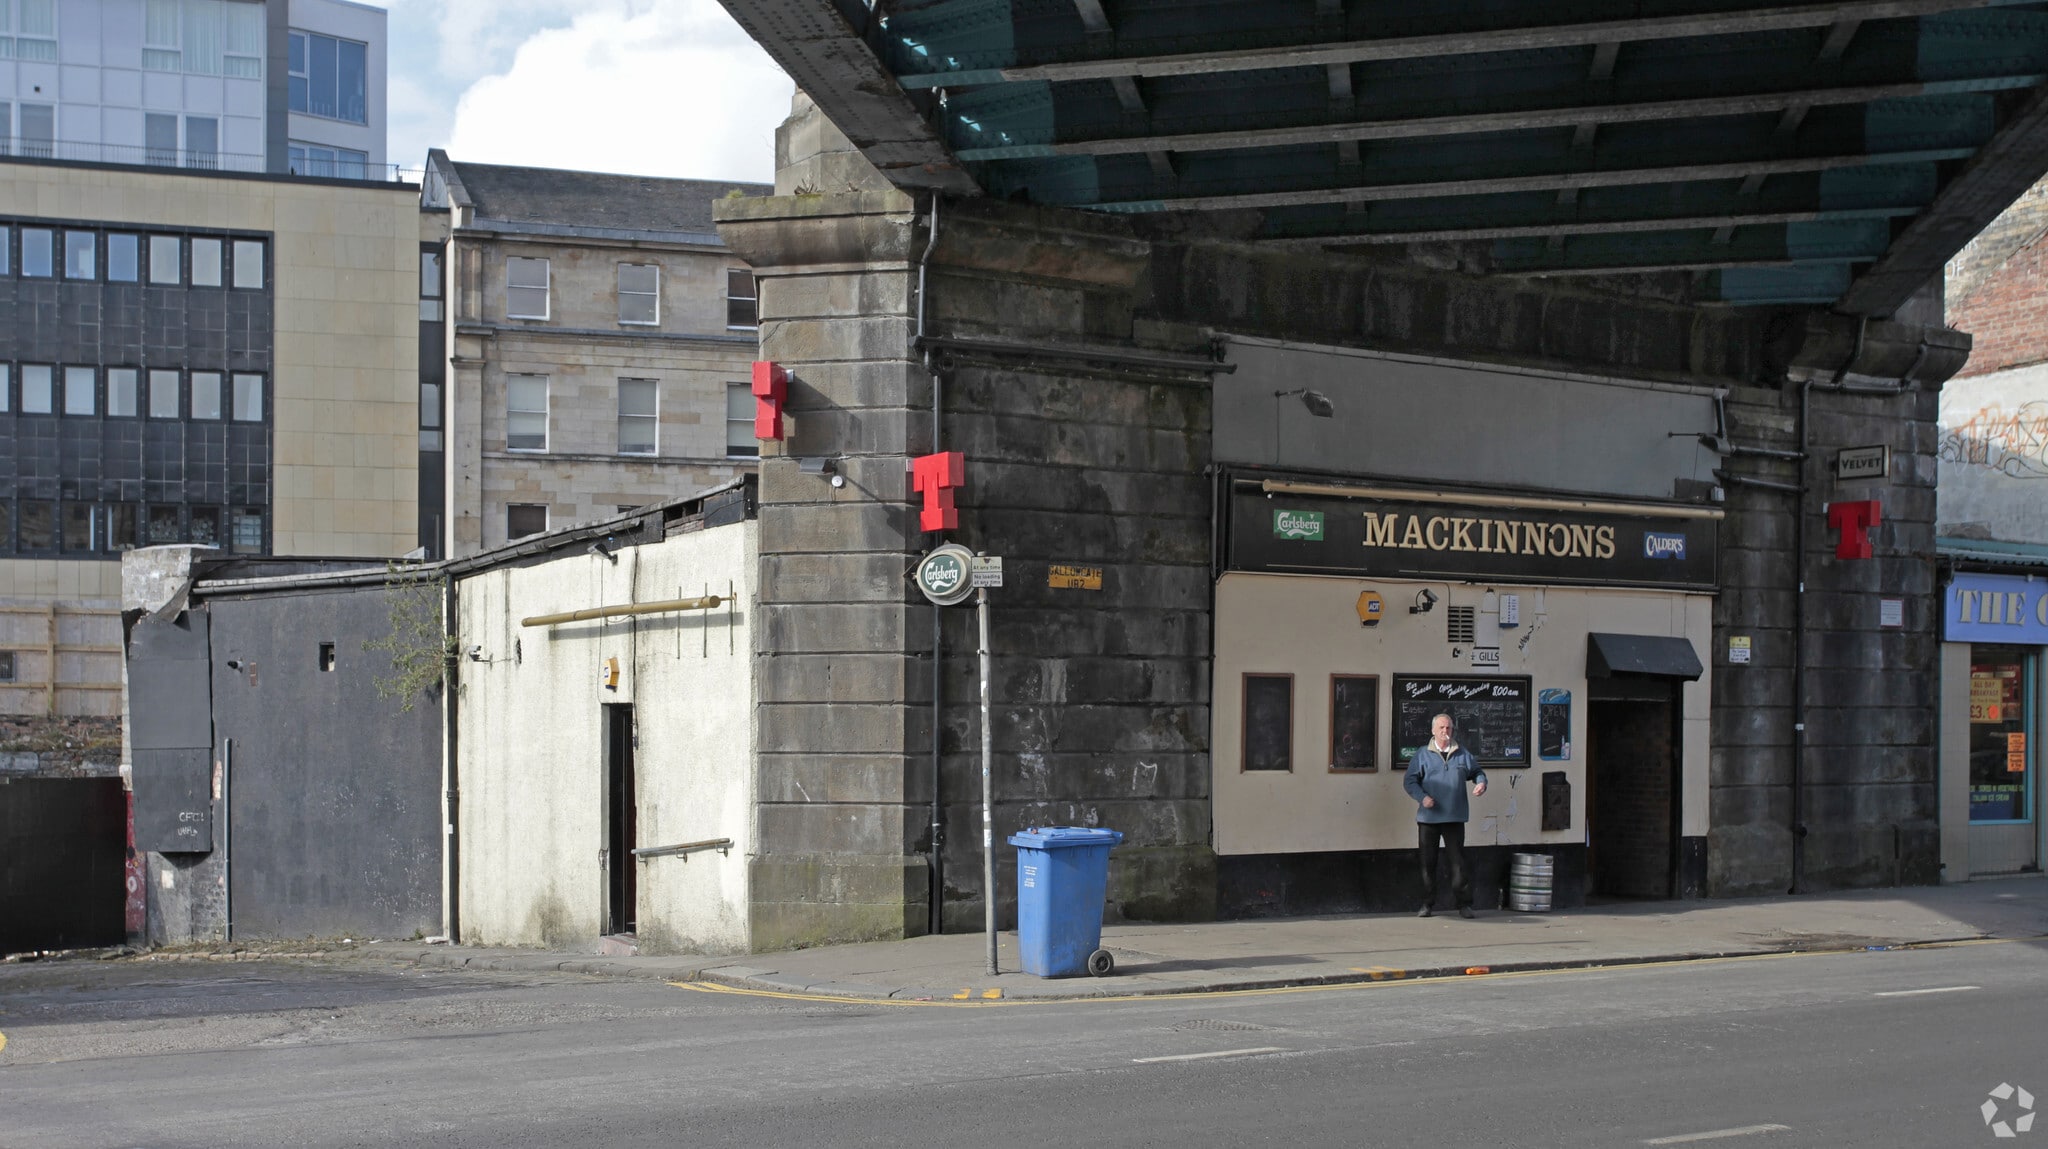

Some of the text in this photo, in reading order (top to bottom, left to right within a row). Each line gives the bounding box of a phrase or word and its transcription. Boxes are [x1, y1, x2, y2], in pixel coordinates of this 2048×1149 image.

[1841, 457, 1881, 470] VELVET
[1277, 511, 1320, 535] Carlsberg
[1828, 500, 1881, 560] T
[1362, 511, 1616, 559] MACKINNONS
[925, 561, 958, 588] Carlsberg
[1369, 602, 1380, 611] ADT
[1955, 588, 2026, 627] THE
[1479, 651, 1500, 662] GILLS
[1405, 682, 1417, 692] Bar
[1464, 682, 1490, 699] Saturday
